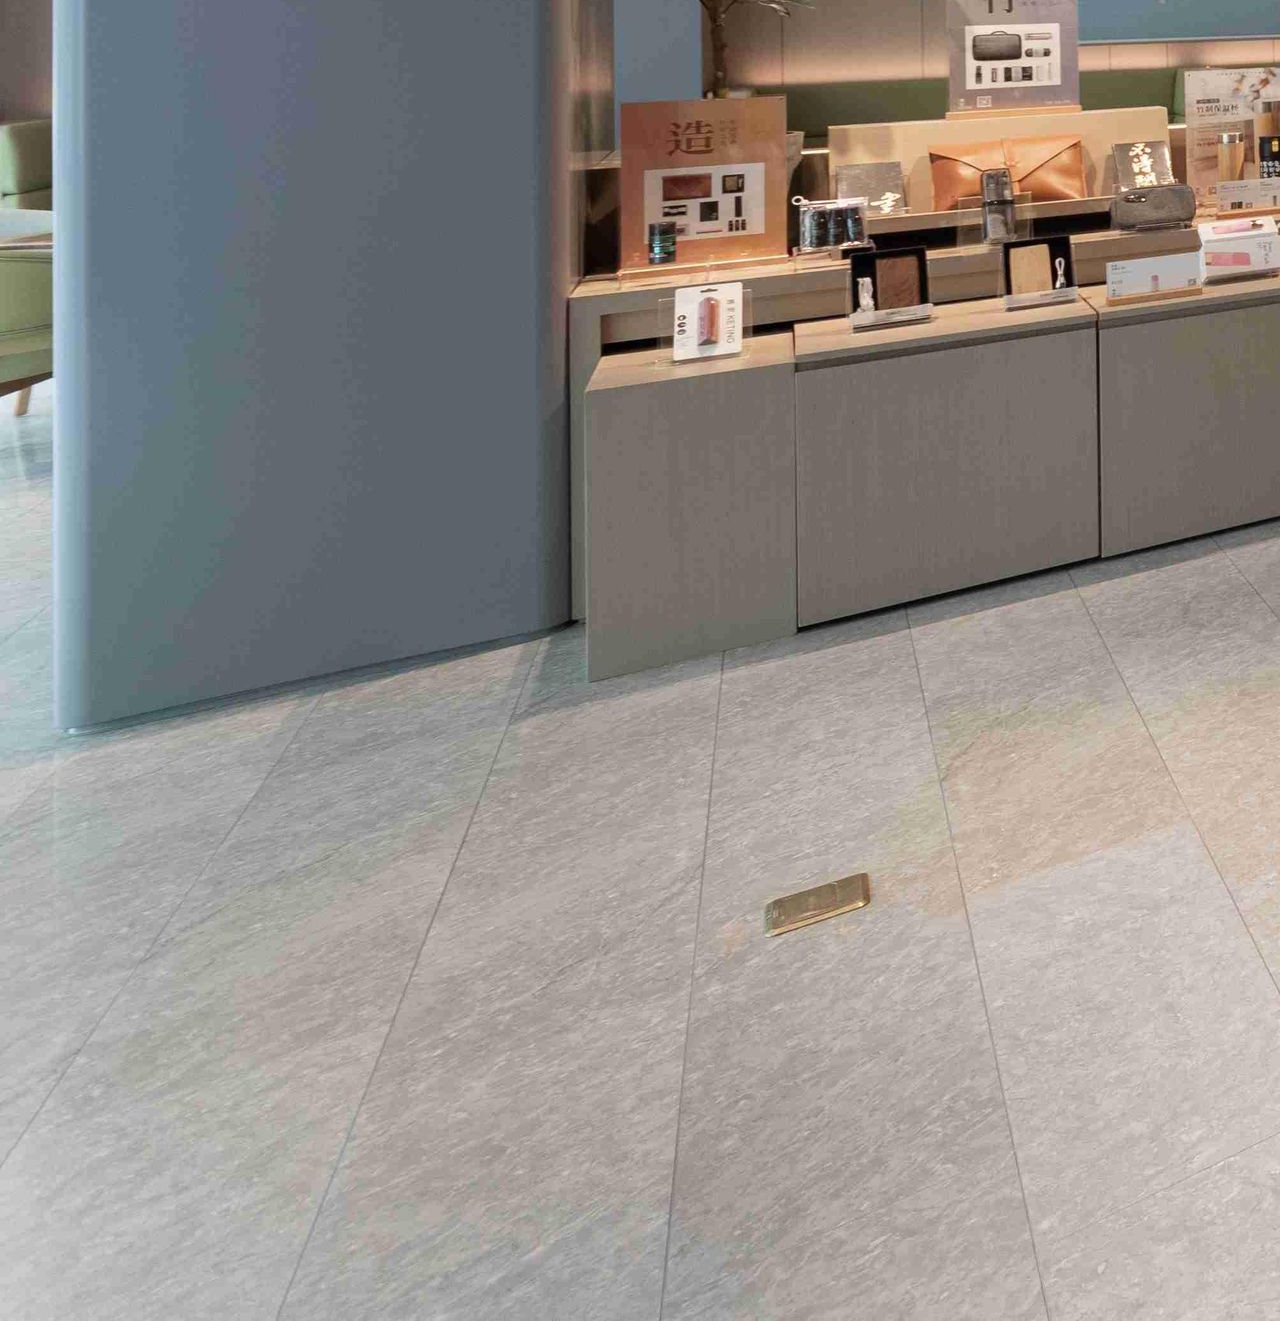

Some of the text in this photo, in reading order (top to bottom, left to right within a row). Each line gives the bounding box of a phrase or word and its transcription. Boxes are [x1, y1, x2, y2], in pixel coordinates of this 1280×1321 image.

[1196, 103, 1239, 114] 竹制保温杯
[665, 120, 715, 156] 造
